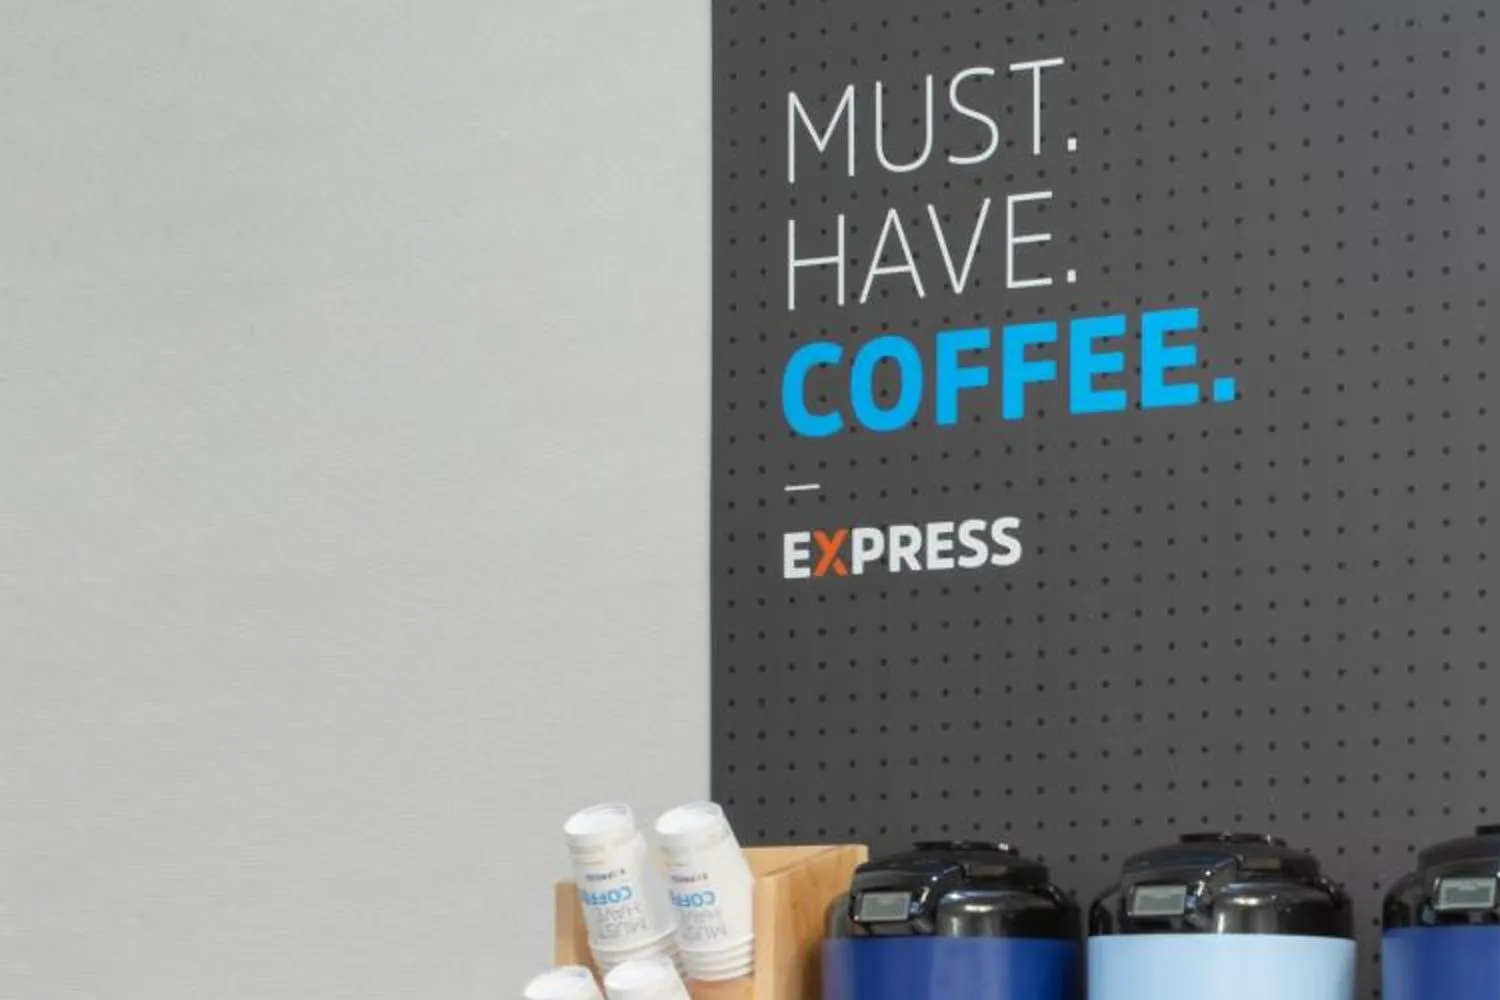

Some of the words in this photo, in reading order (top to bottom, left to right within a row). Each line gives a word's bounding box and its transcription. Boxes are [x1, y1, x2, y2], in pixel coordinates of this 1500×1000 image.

[788, 57, 1077, 183] MUST.
[788, 191, 1077, 310] HAVE.
[781, 307, 1235, 438] COFFEE.
[783, 516, 1022, 579] EXPRESS
